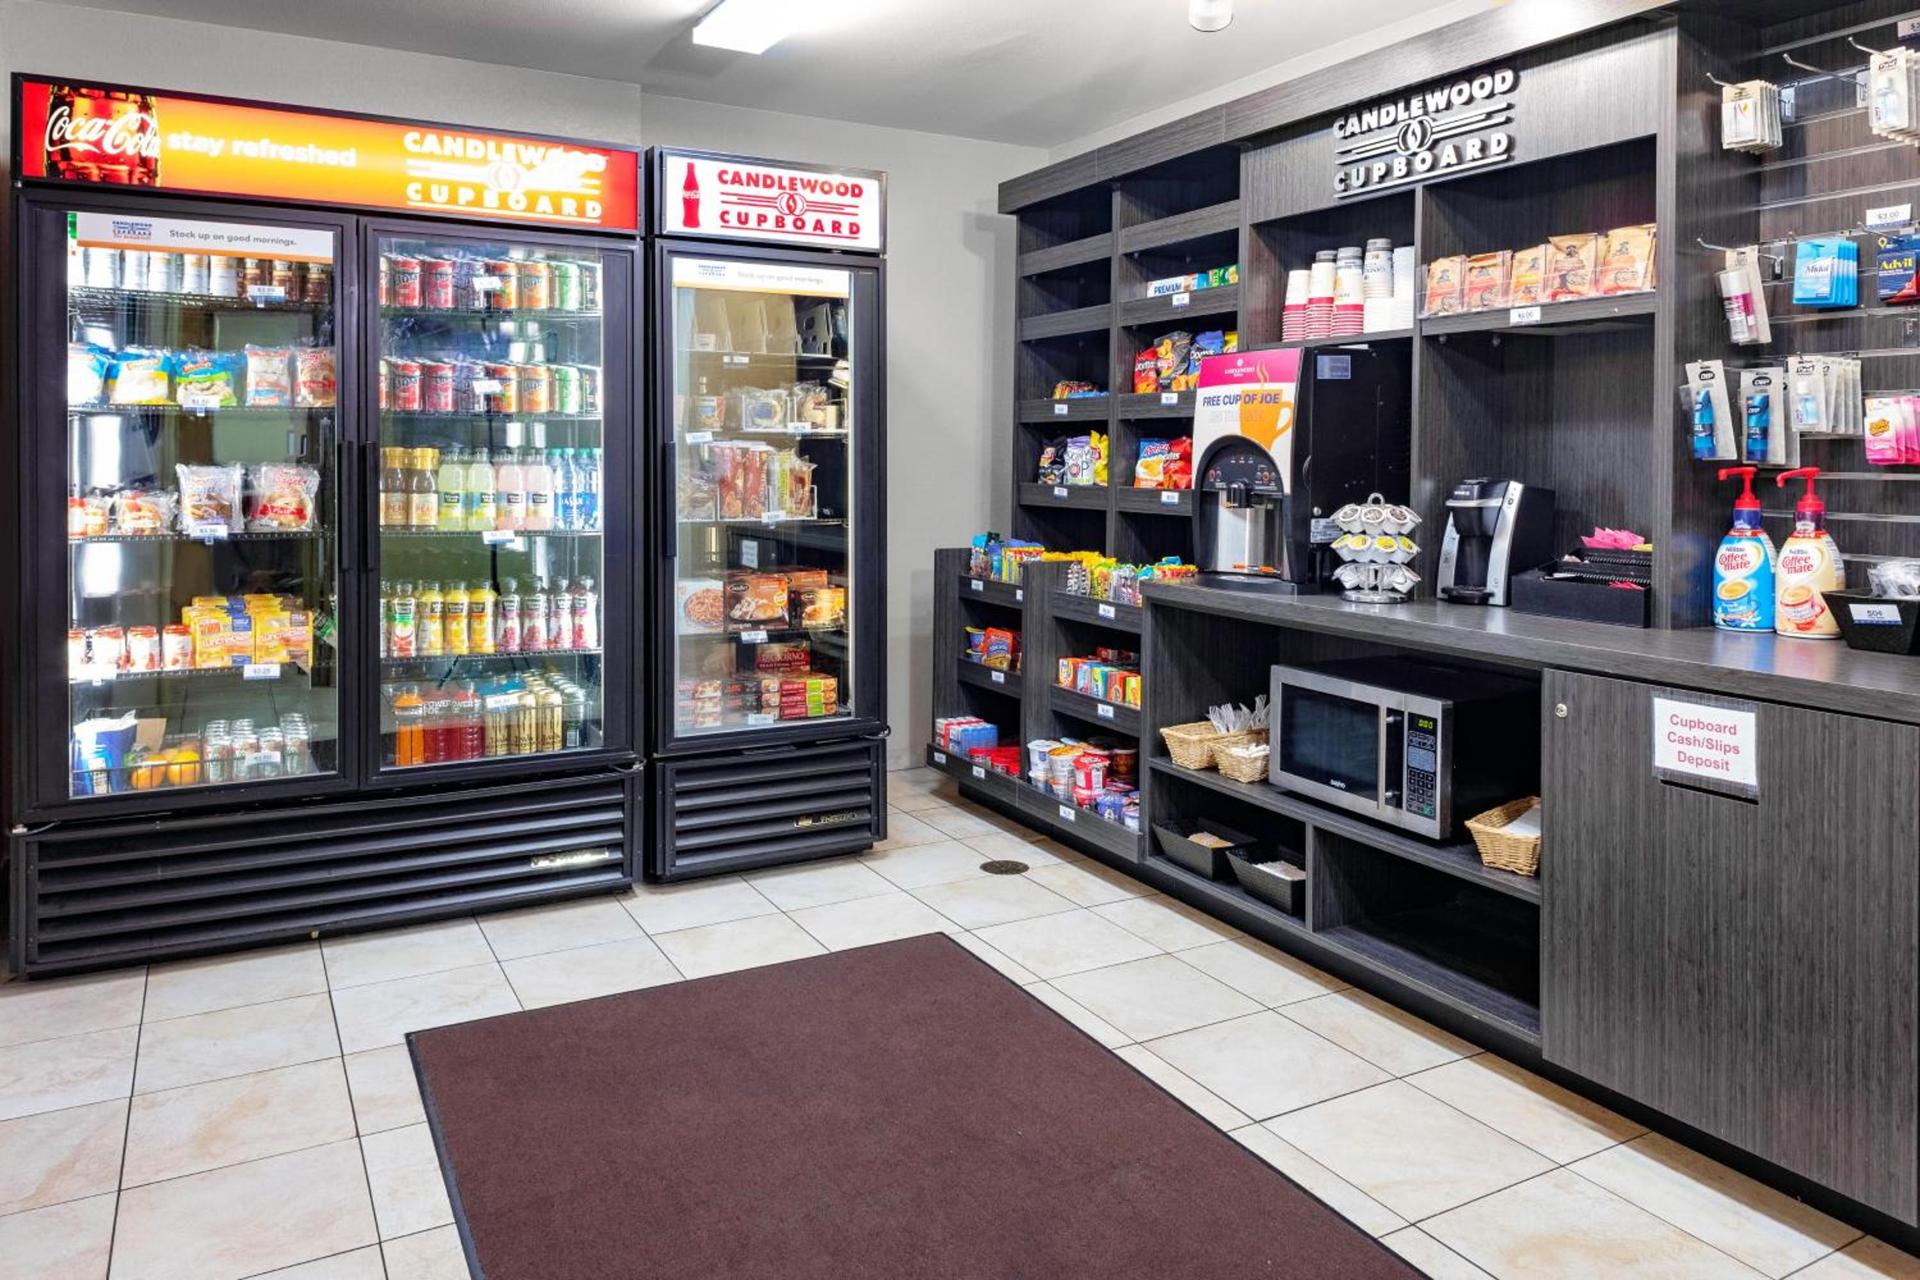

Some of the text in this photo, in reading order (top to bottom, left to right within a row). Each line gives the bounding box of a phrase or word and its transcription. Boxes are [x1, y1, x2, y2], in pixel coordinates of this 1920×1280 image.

[1333, 69, 1514, 139] CANDLEWOOD
[168, 131, 357, 168] stay refreshed
[403, 132, 607, 172] CANDLEWOOD
[1333, 132, 1508, 191] CUPBOARD
[718, 169, 864, 198] CANDLEWOOD
[406, 182, 602, 218] CUPBOARD
[720, 210, 861, 235] CUPBOARD
[169, 229, 196, 239] Stock
[198, 232, 210, 242] up
[227, 233, 251, 245] good
[253, 236, 298, 247] mornings.
[1880, 257, 1914, 270] Advil
[1203, 393, 1280, 407] FREE CUP OF JOE
[1724, 560, 1750, 571] mate
[1787, 564, 1813, 574] mate
[1670, 714, 1737, 736] Cupboard
[1667, 731, 1741, 755] Cash/Slips
[1677, 750, 1730, 772] Deposit
